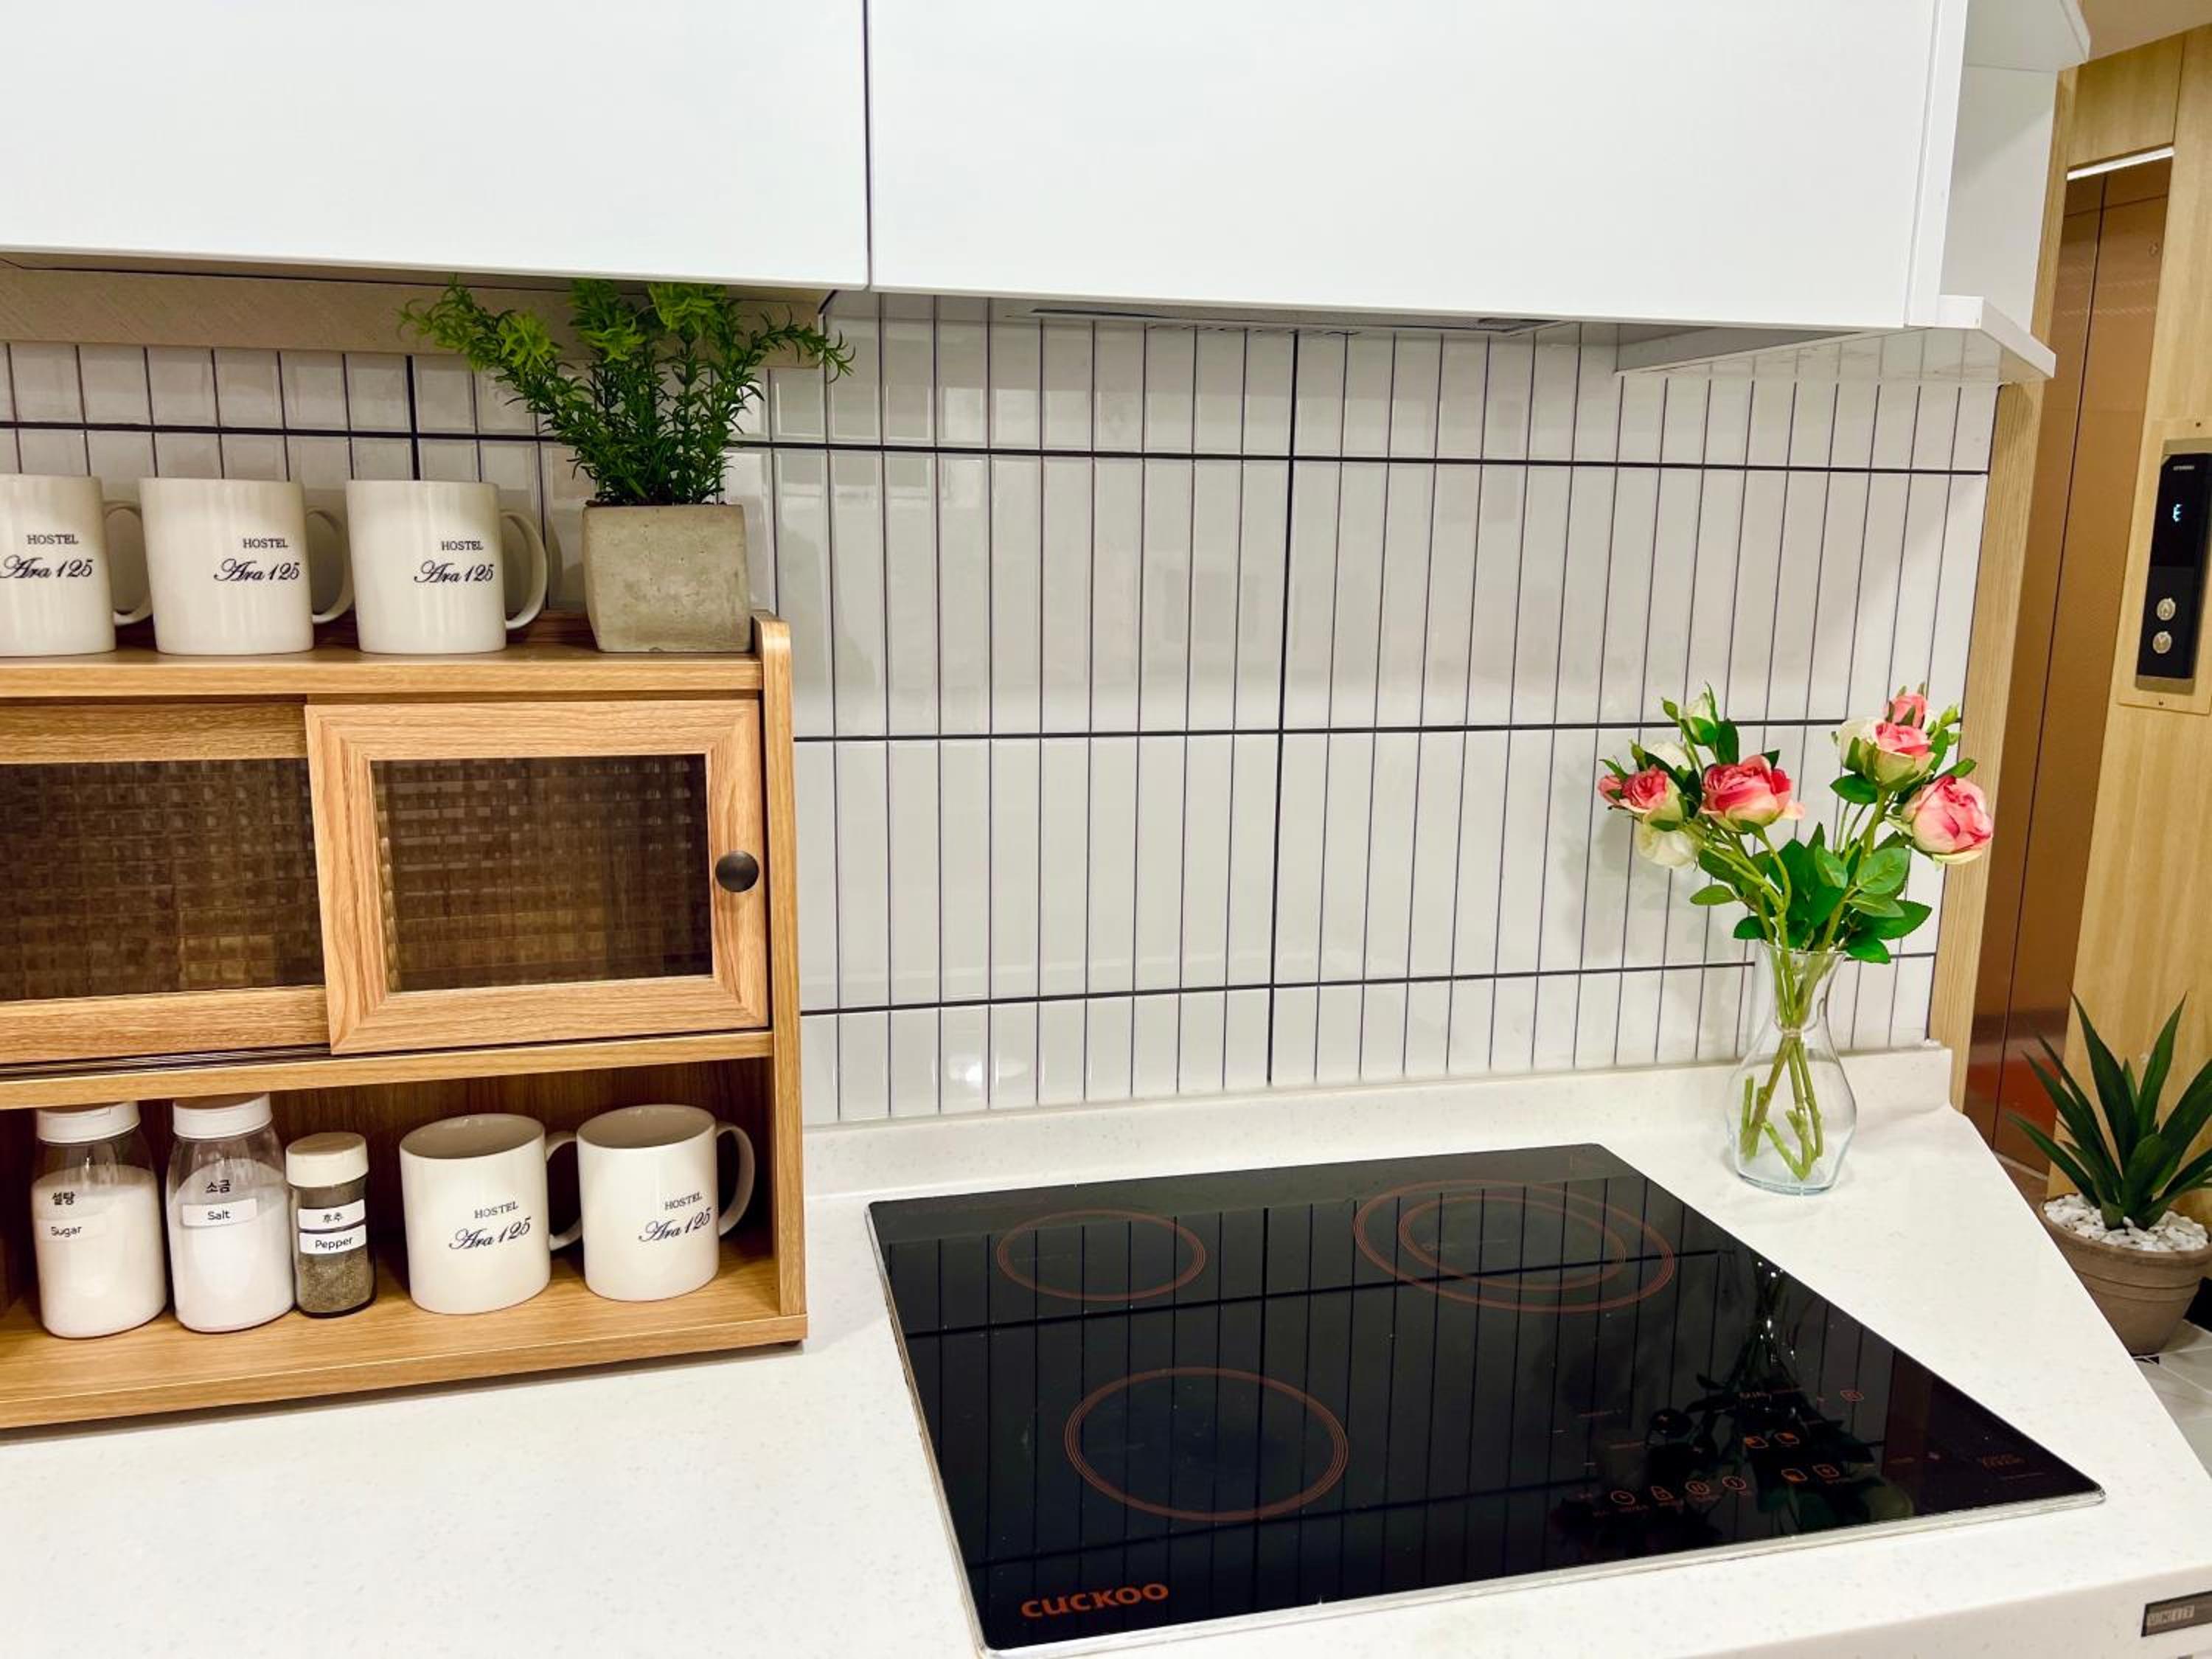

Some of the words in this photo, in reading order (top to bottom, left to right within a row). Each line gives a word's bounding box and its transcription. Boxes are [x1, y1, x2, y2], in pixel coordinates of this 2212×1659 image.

[27, 534, 80, 545] HOSTEL
[243, 538, 289, 549] HOSTEL
[441, 540, 484, 552] HOSTEL
[0, 554, 51, 580] Ara
[55, 558, 94, 578] 125
[214, 558, 264, 582] Ara
[267, 563, 300, 581] 125
[414, 560, 461, 584] Ara
[463, 564, 494, 582] 125
[206, 1180, 231, 1193] 소금
[52, 1192, 75, 1206] 설탕
[664, 1192, 703, 1211] HOSTEL
[207, 1211, 230, 1221] Salt
[473, 1200, 519, 1218] HOSTEL
[322, 1211, 344, 1223] 후추
[638, 1220, 682, 1242] Ara
[685, 1207, 712, 1233] 125
[51, 1226, 82, 1238] Sugar
[448, 1228, 495, 1249] Ara
[497, 1216, 531, 1242] 125
[316, 1237, 353, 1251] Pepper
[1020, 1583, 1169, 1618] CUCKOO
